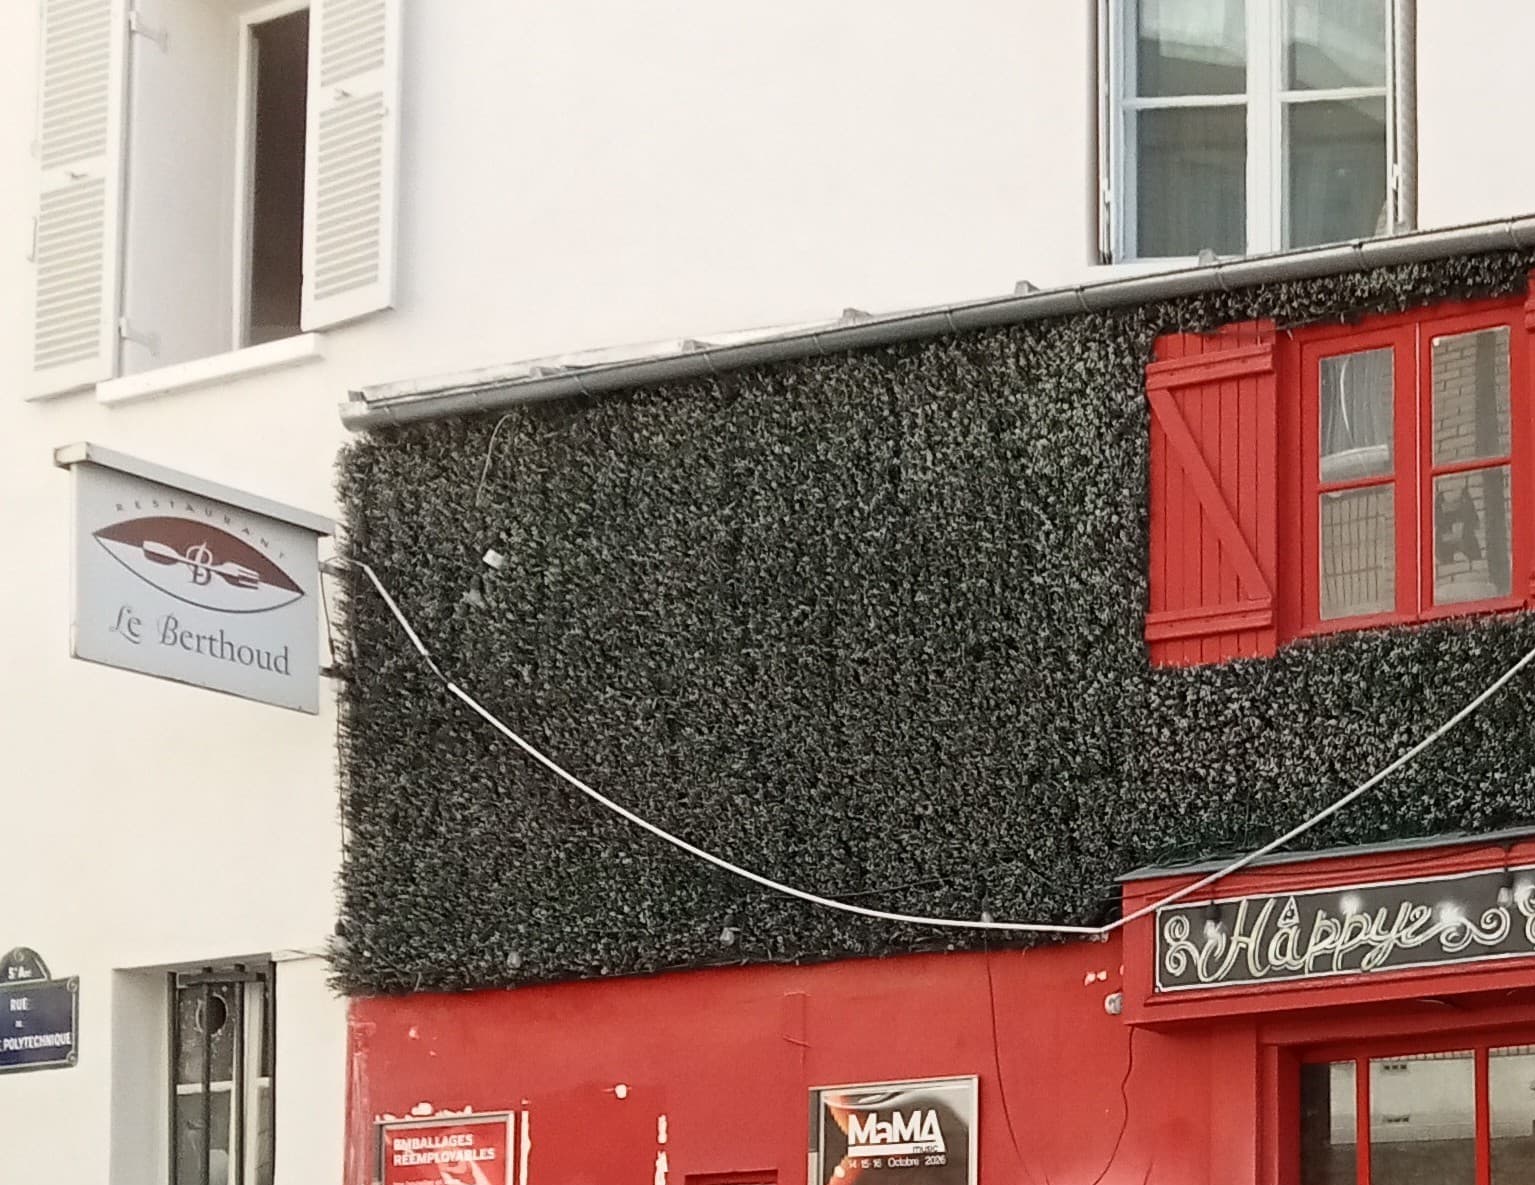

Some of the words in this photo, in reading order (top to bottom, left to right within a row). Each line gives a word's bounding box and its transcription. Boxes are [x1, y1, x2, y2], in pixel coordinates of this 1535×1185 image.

[115, 499, 285, 560] RESTAURANT
[109, 605, 143, 645] Le
[158, 612, 292, 677] Berthoud
[3, 1032, 71, 1051] POLYTECHNIQUE
[393, 1133, 473, 1150] EMBALLAGES
[848, 1109, 945, 1152] MaMA
